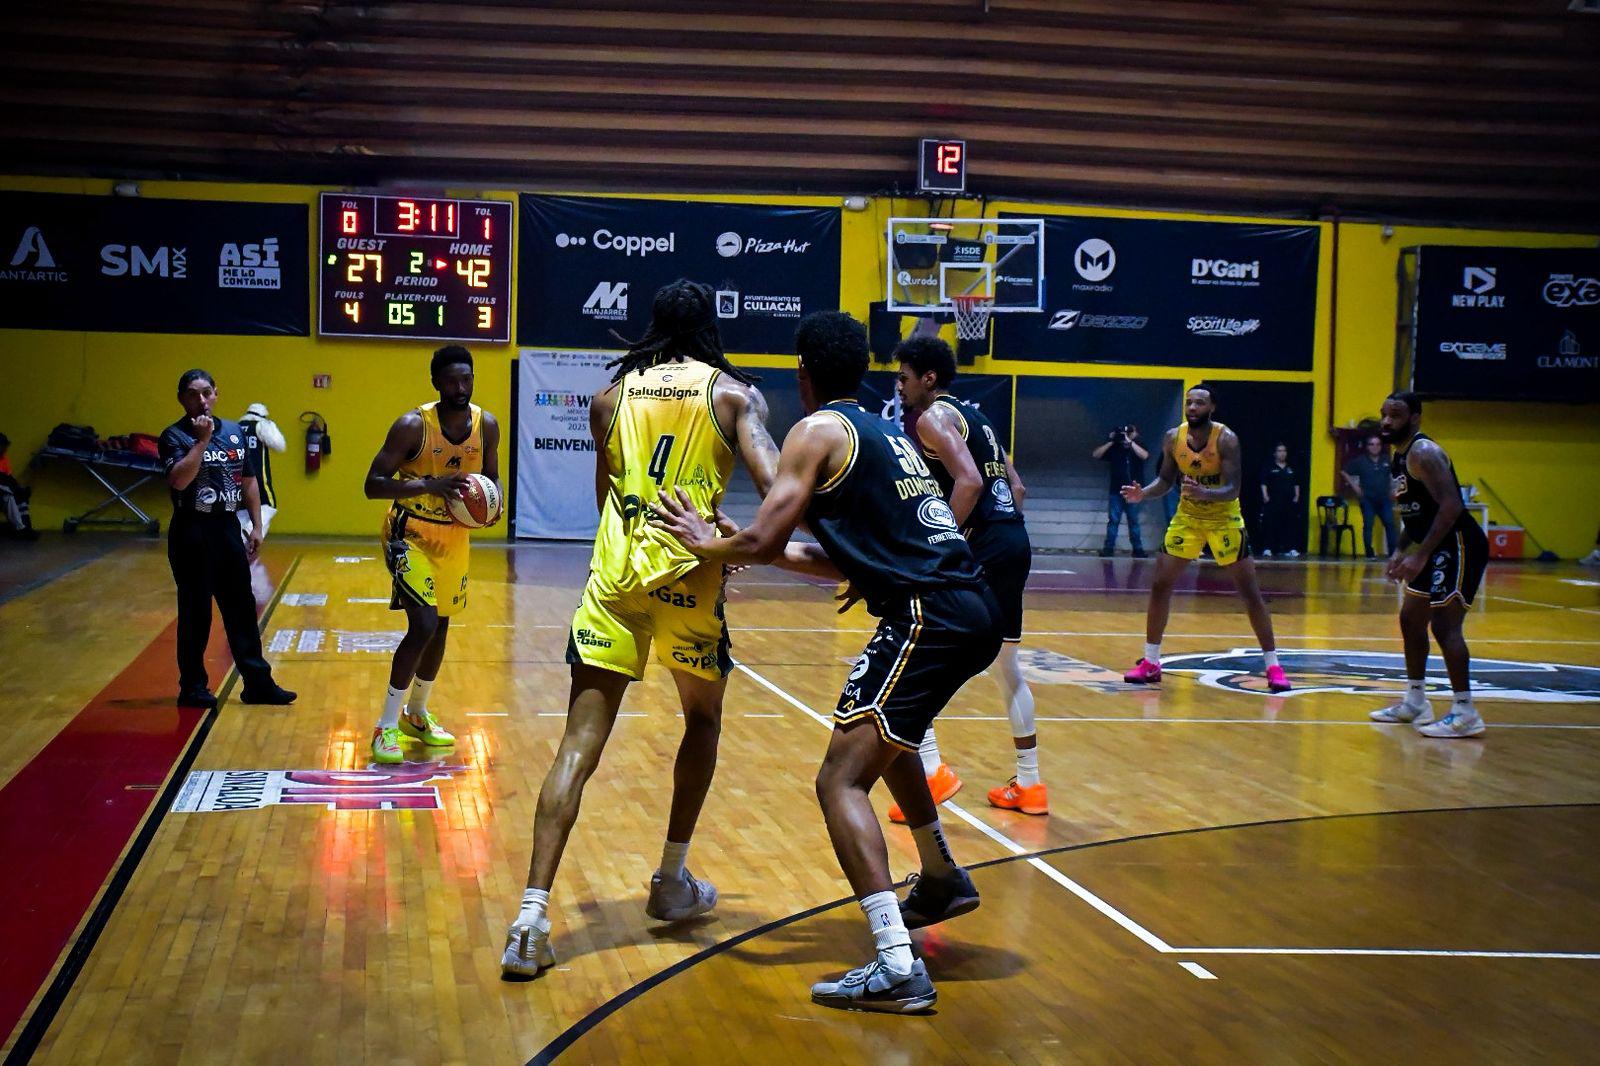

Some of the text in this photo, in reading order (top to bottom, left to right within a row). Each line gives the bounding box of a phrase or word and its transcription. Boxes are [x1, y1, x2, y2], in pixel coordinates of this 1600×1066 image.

[937, 145, 961, 174] 12
[341, 201, 358, 209] TOL
[475, 207, 492, 216] TOL
[342, 211, 358, 234] 0
[397, 201, 454, 233] 3:11
[483, 218, 491, 240] 1
[337, 237, 387, 251] GUEST
[449, 243, 493, 256] HOME
[593, 229, 675, 257] Coppel
[744, 237, 811, 254] Pizza Hut
[961, 246, 981, 255] ISDE
[220, 237, 279, 267] ASÍ
[347, 253, 382, 283] 27
[410, 251, 424, 274] 2
[1192, 258, 1260, 279] D'Gari
[0, 270, 68, 282] ANTARTIC
[223, 269, 255, 278] ME LO
[456, 259, 491, 288] 42
[898, 271, 938, 286] Kuroda
[222, 277, 278, 286] CONTARON
[395, 276, 438, 287] PERIOD
[335, 291, 364, 299] FOULS
[385, 293, 448, 303] PLAYER-FOUL
[468, 296, 496, 304] FOULS
[1452, 294, 1505, 308] NEW PLAY
[345, 301, 359, 324] 4
[582, 308, 628, 316] MANJARREZ
[743, 300, 801, 312] CULIACÁN
[388, 303, 415, 326] 05
[437, 305, 444, 327] 1
[478, 306, 492, 329] 3
[628, 386, 699, 400] SaludDigna
[568, 423, 587, 431] 2025
[534, 437, 597, 452] BIENVENI
[647, 434, 676, 486] 4
[212, 771, 269, 811] SINALOA
